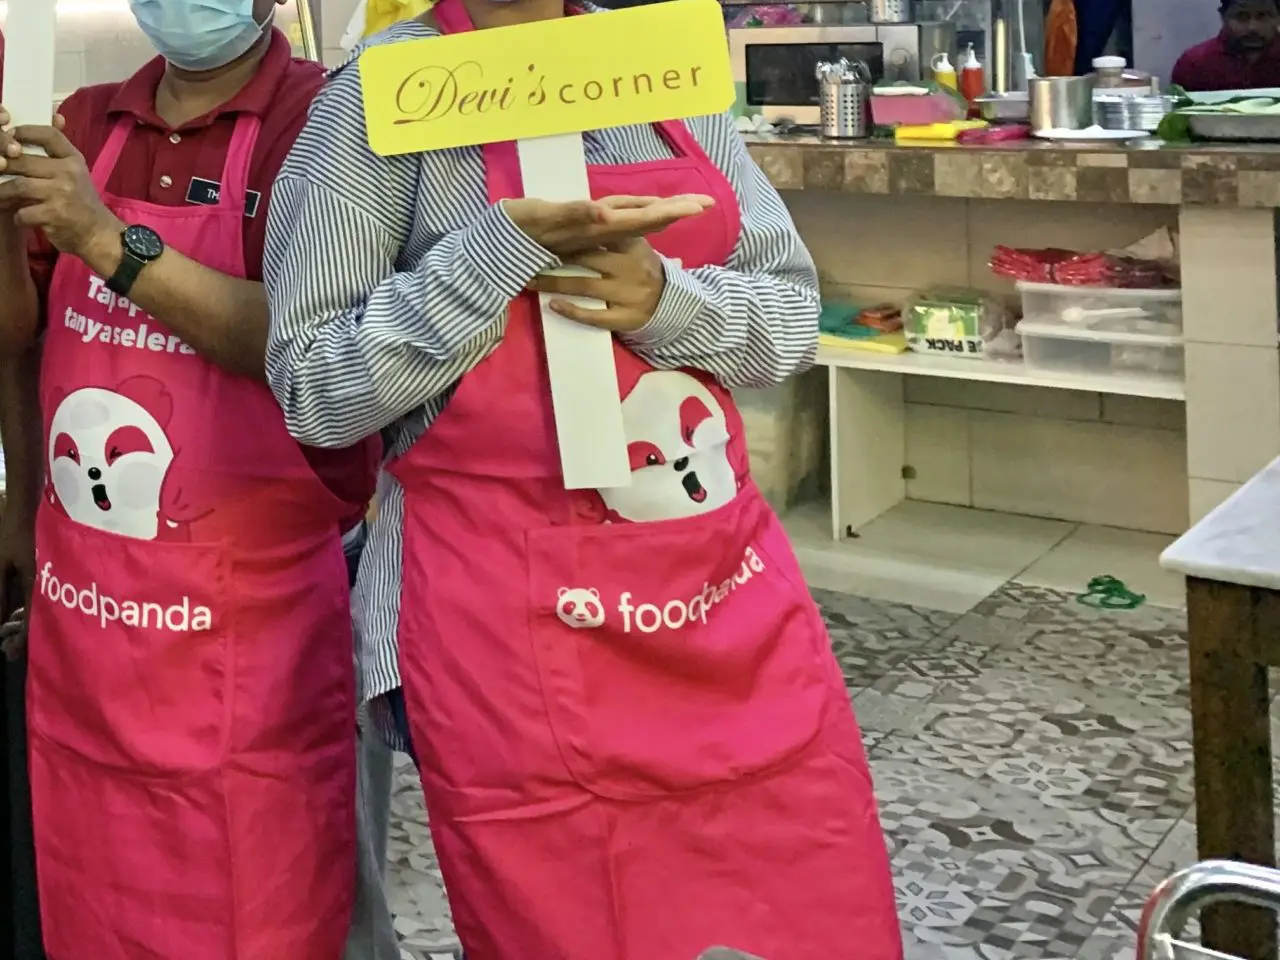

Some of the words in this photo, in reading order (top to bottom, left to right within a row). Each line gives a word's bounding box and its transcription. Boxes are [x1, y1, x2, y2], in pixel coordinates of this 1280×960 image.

[393, 60, 547, 125] Devi's
[558, 64, 702, 105] corner
[207, 188, 220, 200] TH
[926, 338, 964, 353] PACK
[40, 561, 212, 633] foodpanda
